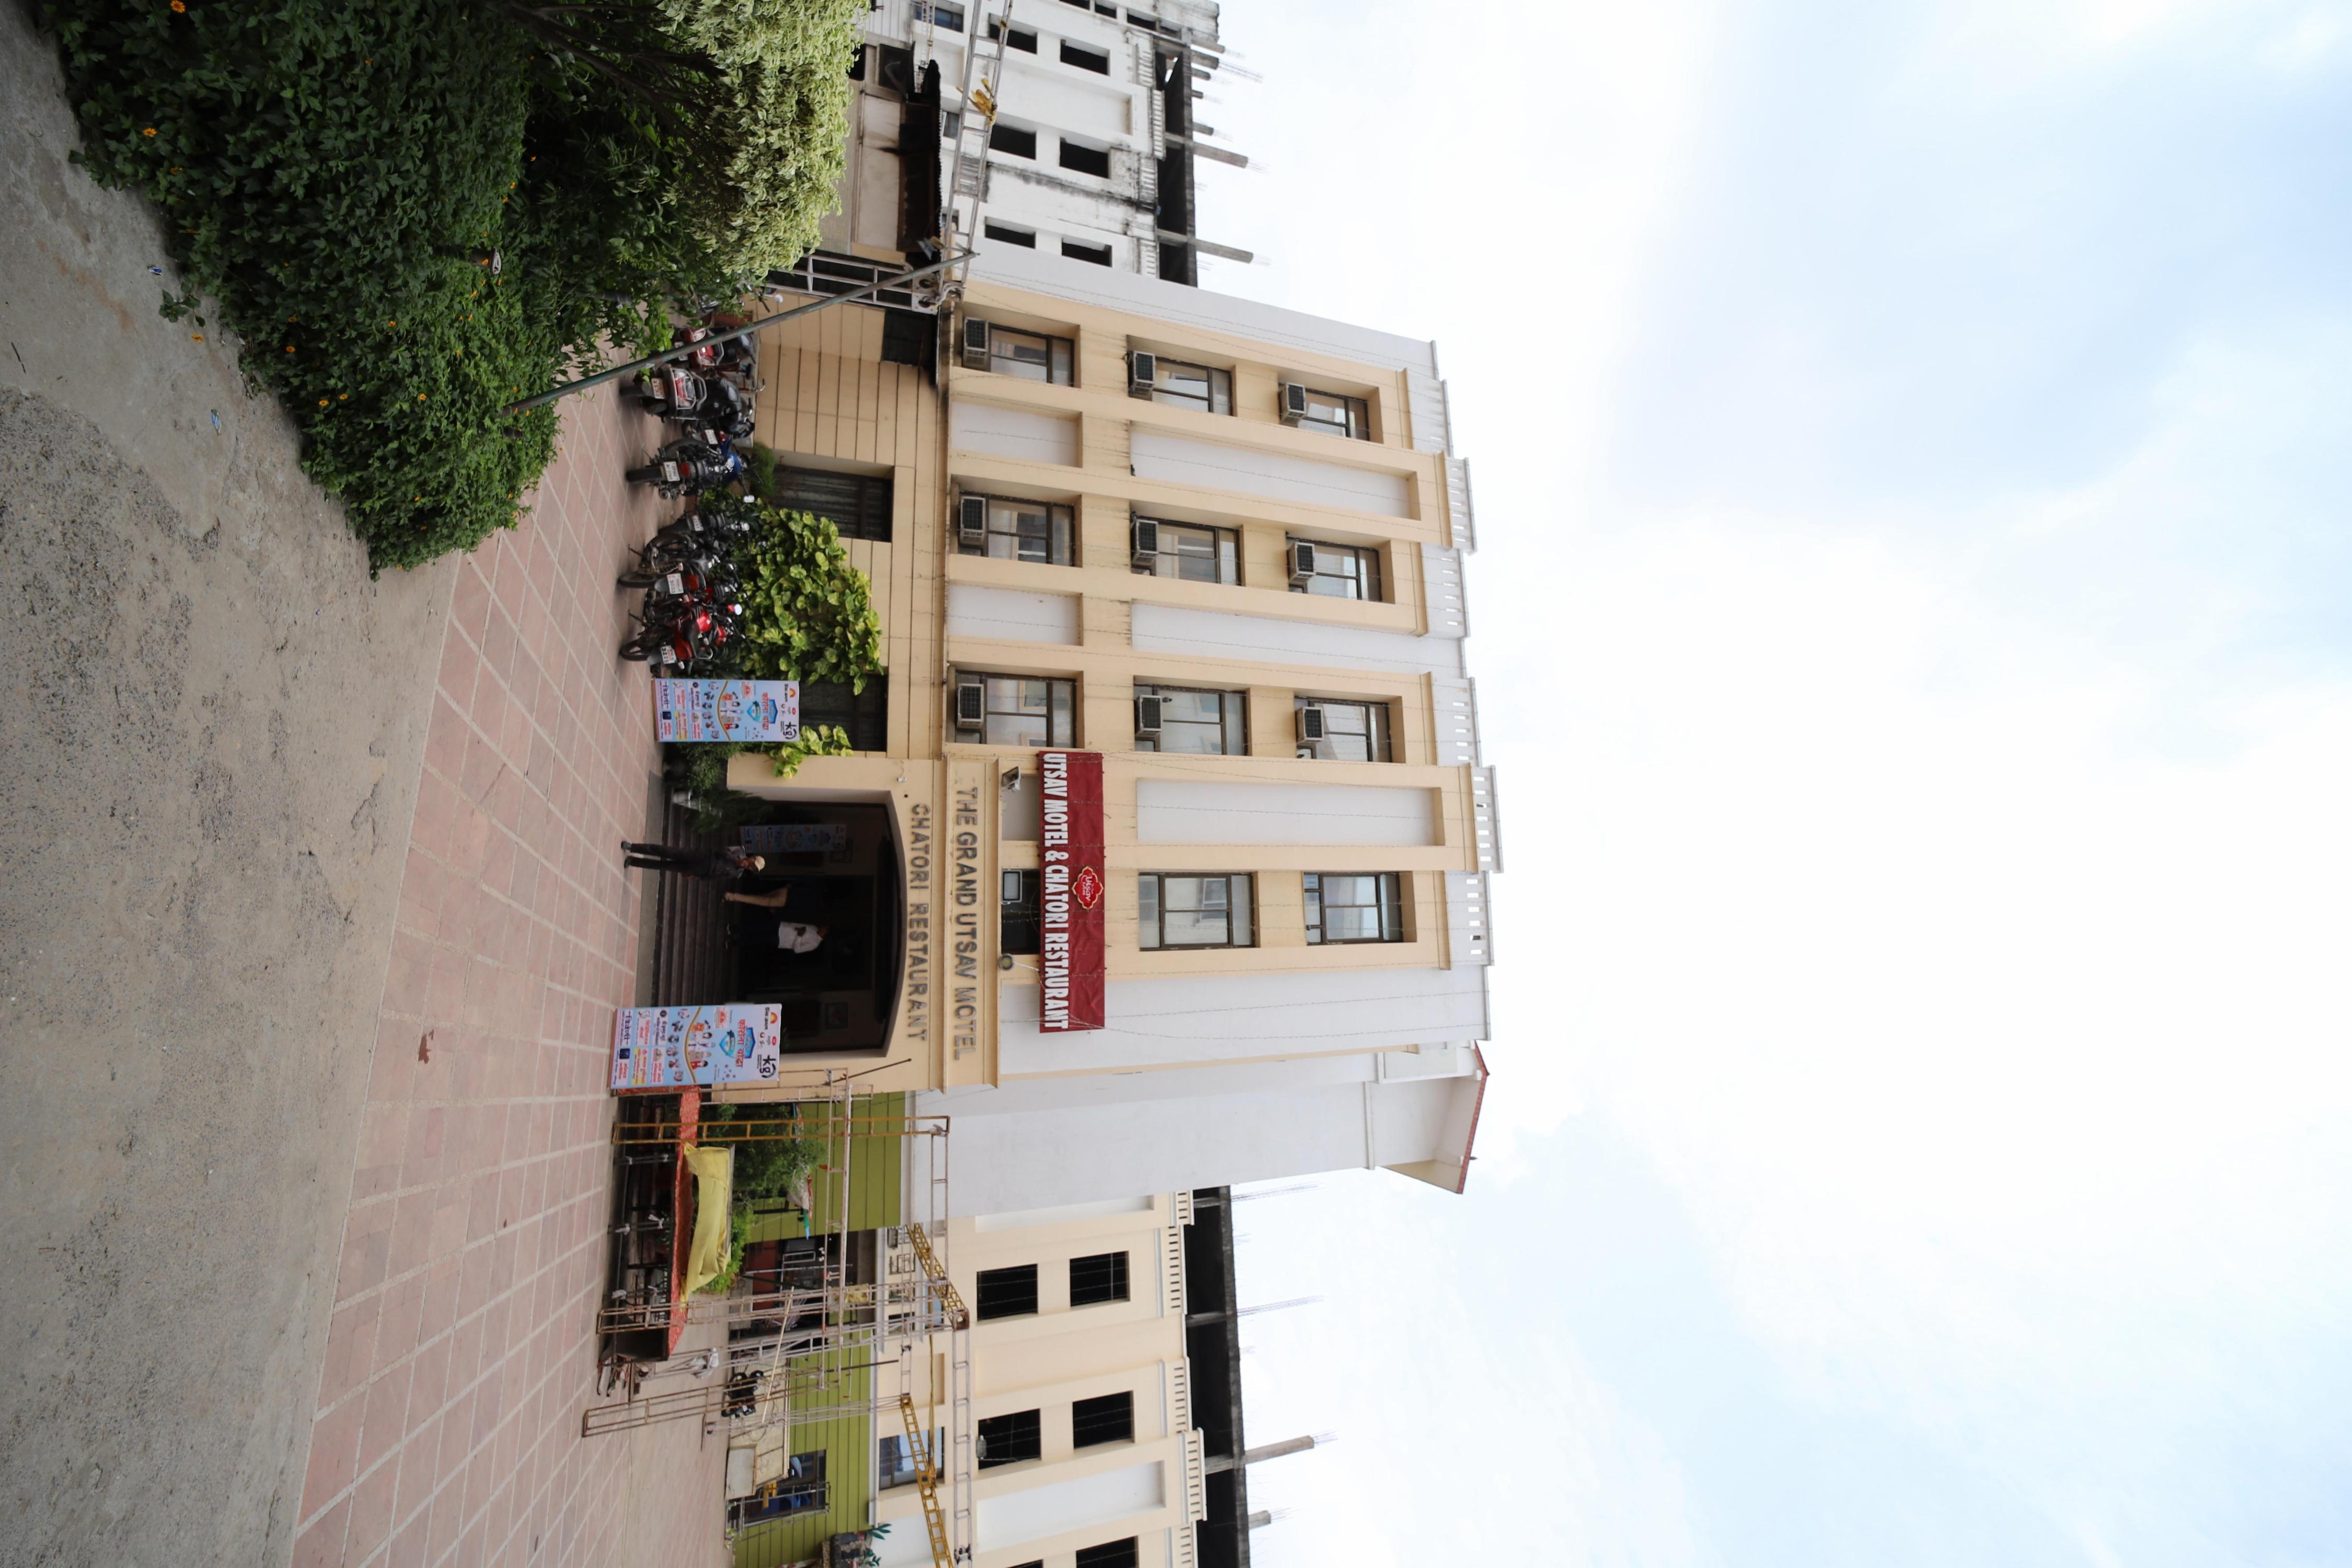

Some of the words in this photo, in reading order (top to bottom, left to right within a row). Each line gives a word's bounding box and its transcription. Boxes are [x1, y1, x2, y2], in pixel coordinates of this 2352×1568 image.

[957, 787, 978, 825] THE
[1044, 753, 1067, 797] UTSAV
[911, 804, 930, 890] CHATORI
[1044, 800, 1068, 846] MOTEL
[1046, 850, 1068, 861] &
[956, 832, 977, 906] GRAND
[1045, 865, 1069, 928] CHATORI
[908, 904, 929, 1041] RESTAURANT
[955, 913, 977, 979] UTSAV
[1044, 933, 1069, 1029] RESTAURANT
[954, 987, 976, 1060] MOTEL
